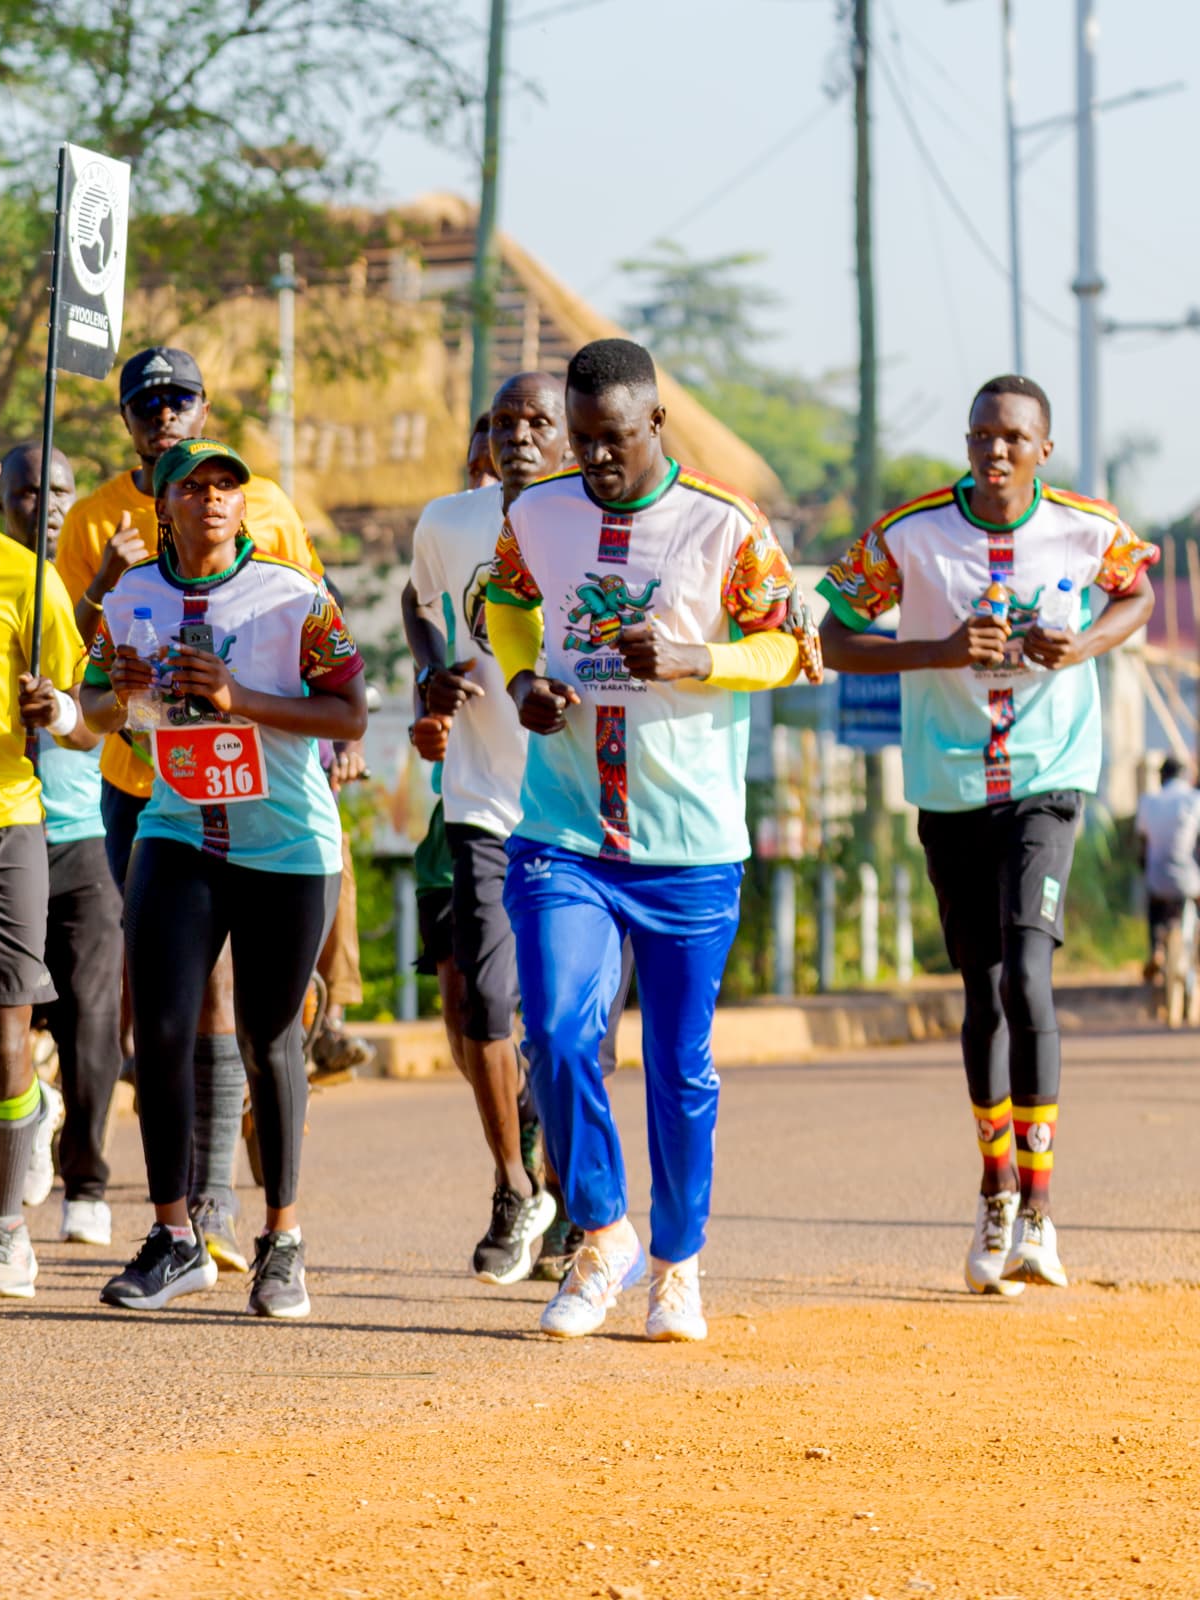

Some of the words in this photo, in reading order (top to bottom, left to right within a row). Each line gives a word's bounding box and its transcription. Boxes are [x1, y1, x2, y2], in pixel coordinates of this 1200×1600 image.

[574, 657, 631, 682] GUL
[215, 742, 242, 751] 21KM
[205, 763, 254, 797] 316
